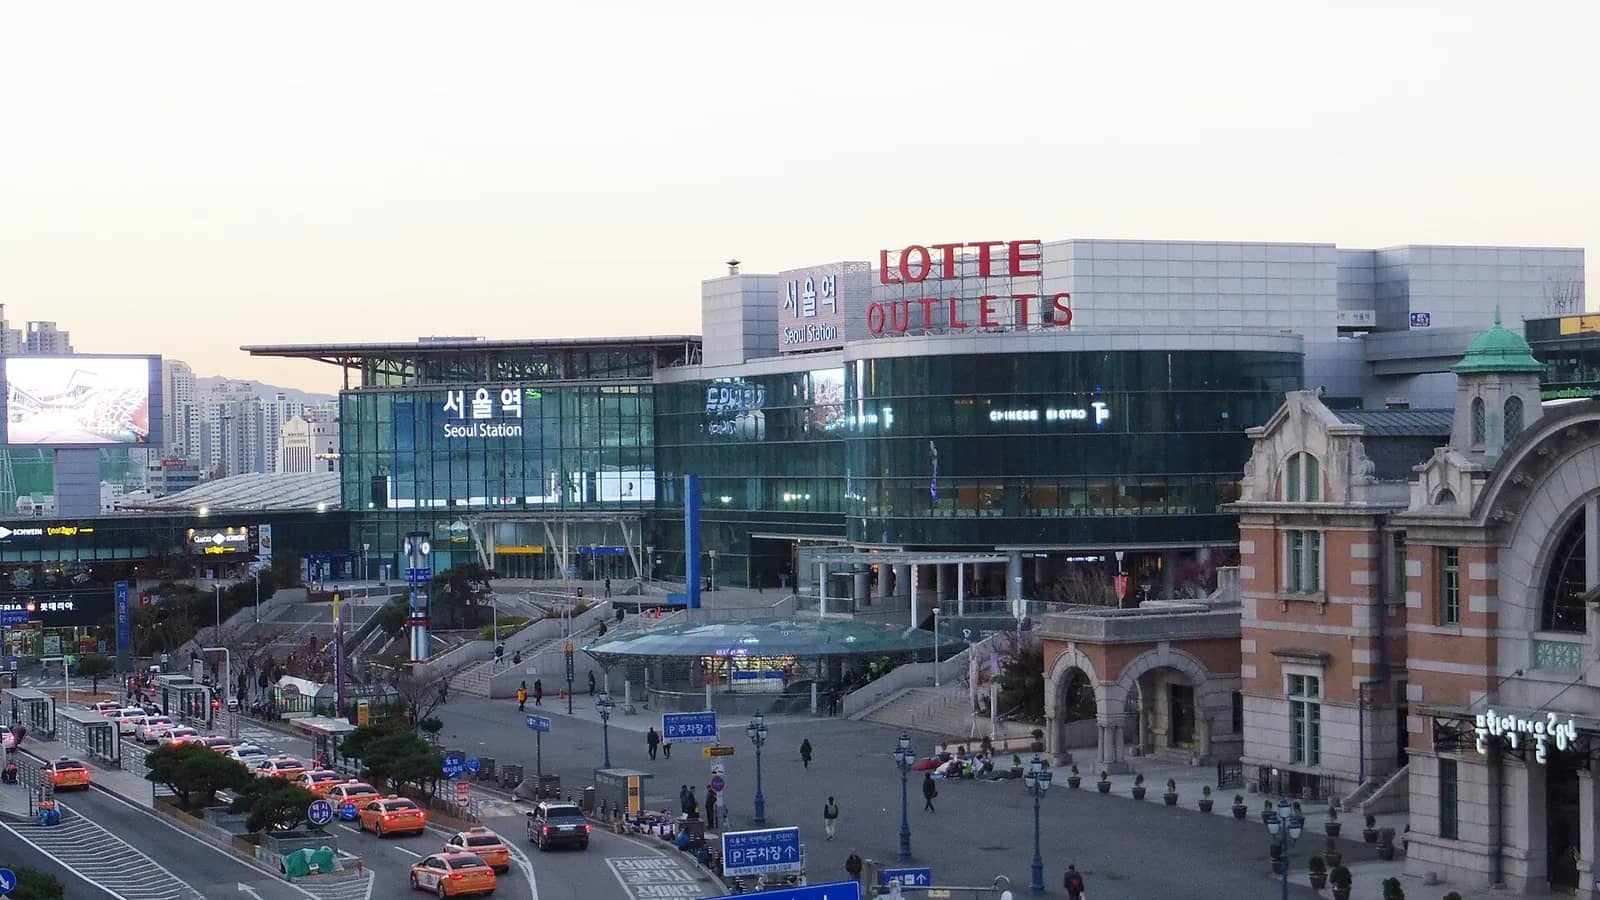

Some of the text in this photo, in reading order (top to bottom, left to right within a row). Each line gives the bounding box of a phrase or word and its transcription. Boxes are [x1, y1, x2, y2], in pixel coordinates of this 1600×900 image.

[879, 239, 1041, 285] LOTTE
[783, 275, 838, 318] 서울역
[867, 292, 1073, 334] OUTLETS
[783, 323, 838, 345] Seoul Station
[443, 388, 522, 420] 서울역
[989, 409, 1039, 421] CHINESE
[1046, 409, 1087, 420] BISTRO
[443, 423, 522, 438] Seoul Station
[40, 602, 73, 612] 롯데리아
[678, 723, 703, 735] 주차장
[733, 845, 782, 863] P 주차장
